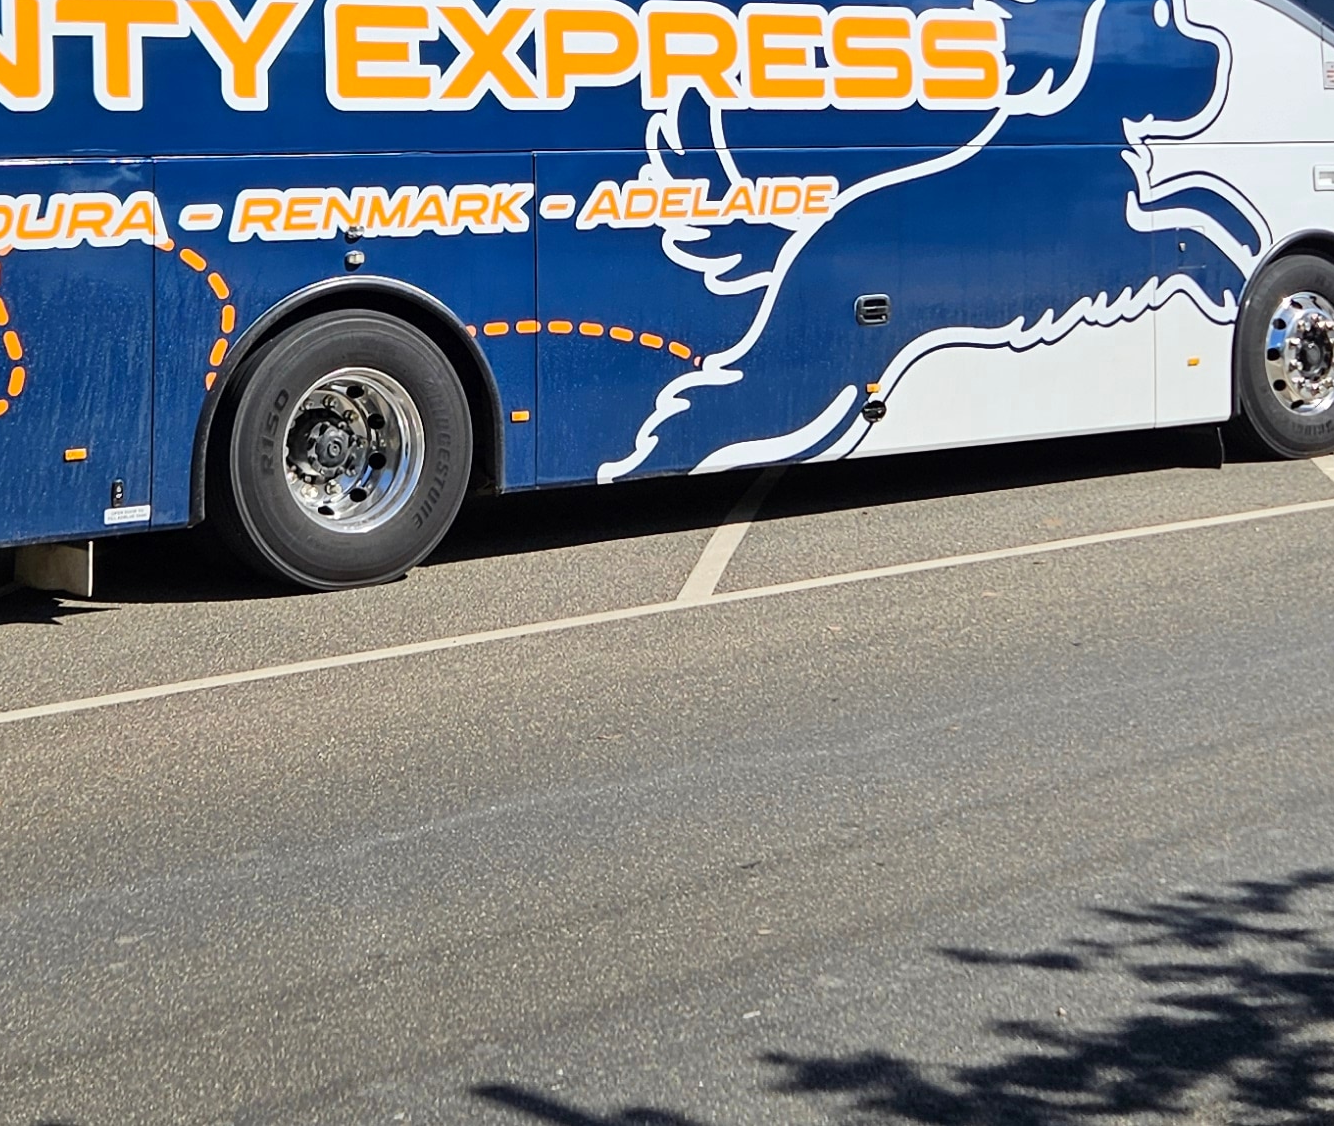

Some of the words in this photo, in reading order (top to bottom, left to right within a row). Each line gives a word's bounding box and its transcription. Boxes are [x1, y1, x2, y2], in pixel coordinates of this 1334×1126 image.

[229, 183, 534, 243] RENMARK
[576, 176, 840, 230] ADELAIDE
[258, 388, 290, 475] R150
